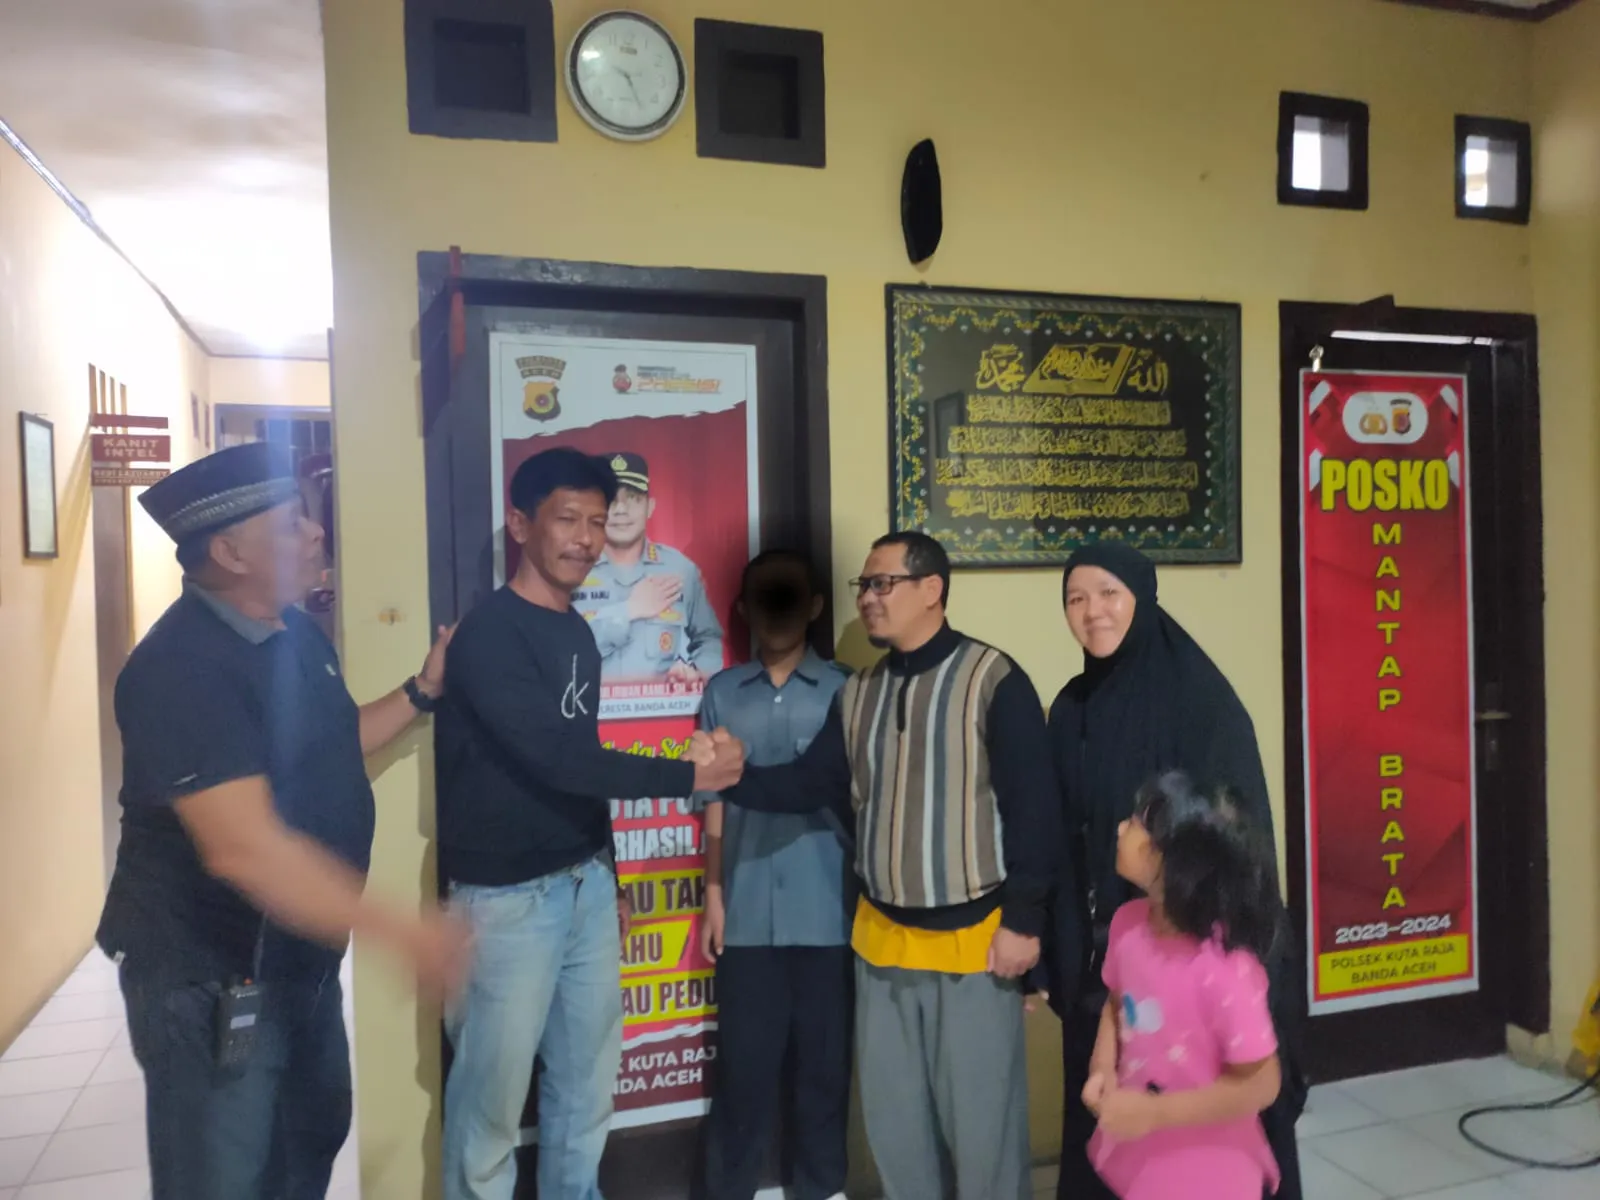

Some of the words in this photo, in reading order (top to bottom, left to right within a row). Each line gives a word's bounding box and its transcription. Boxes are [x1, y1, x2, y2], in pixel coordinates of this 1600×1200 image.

[103, 438, 158, 448] KANIT
[105, 448, 158, 458] INTEL
[1320, 458, 1450, 512] POSKO
[1371, 522, 1402, 712] MANTAP
[634, 699, 665, 713] BANDA
[667, 699, 691, 711] ACEH
[1379, 754, 1407, 911] BRATA
[1331, 952, 1383, 970] POLSEK
[1385, 947, 1419, 962] KUTA
[1422, 942, 1456, 957] RAJA
[1351, 967, 1399, 984] BANDA
[1402, 961, 1437, 976] ACEH
[628, 1051, 678, 1072] KUTA
[651, 1068, 703, 1090] ACEH
